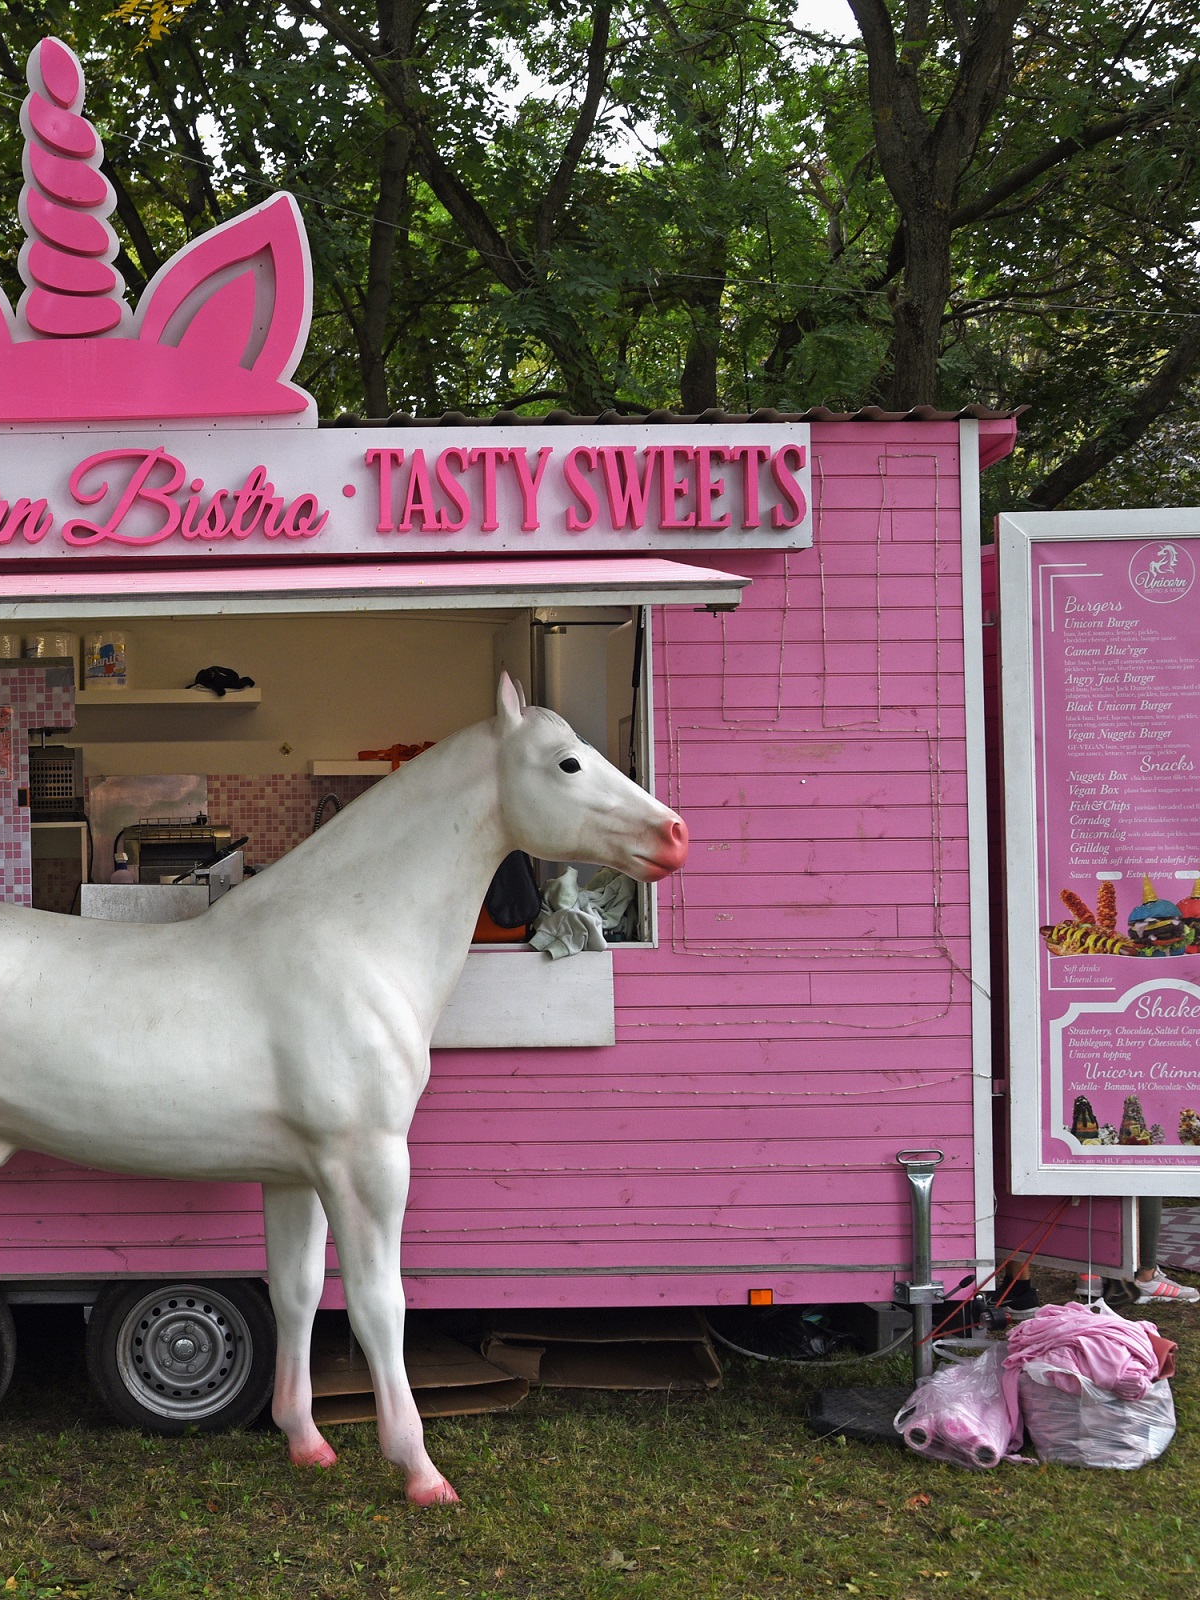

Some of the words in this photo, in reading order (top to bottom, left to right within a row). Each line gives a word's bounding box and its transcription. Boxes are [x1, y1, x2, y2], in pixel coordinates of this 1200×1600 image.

[366, 446, 552, 533] TASTY
[564, 444, 807, 531] SWEETS
[61, 446, 328, 548] Bistro
[1135, 571, 1187, 589] Unicorn
[1065, 596, 1124, 616] Burgers
[1064, 618, 1103, 629] Unicorn
[1107, 617, 1140, 630] Burger
[1065, 646, 1100, 656] Camem
[1064, 674, 1094, 687] Angry
[1095, 673, 1120, 687] Jack
[1123, 673, 1155, 685] Burger
[1066, 702, 1094, 712] Black
[1097, 701, 1136, 711] Unicorn
[1140, 700, 1173, 712] Burger
[1067, 730, 1095, 742] Vegan
[1097, 729, 1136, 741] Nuggets
[1139, 728, 1172, 741] Burger
[1140, 755, 1195, 772] Snacks
[1066, 771, 1105, 783] Nuggets
[1108, 770, 1128, 781] Box
[1069, 785, 1096, 797] Vegan
[1100, 785, 1119, 794] Box
[1069, 800, 1131, 813] Fish&Chips
[1069, 815, 1111, 827] Corndog
[1070, 828, 1127, 841] Unicorndog
[1070, 843, 1110, 855] Grilldog
[1069, 857, 1090, 865] Menu
[1110, 857, 1122, 866] soft
[1124, 856, 1143, 864] drink
[1144, 856, 1158, 864] and
[1160, 856, 1185, 865] colorful
[1186, 855, 1200, 865] frie
[1069, 871, 1092, 879] Sauces
[1126, 870, 1147, 878] Extra
[1148, 871, 1173, 879] topping
[1063, 965, 1078, 974] Soft
[1136, 995, 1200, 1019] Shake
[1068, 1026, 1112, 1037] Strawberry,
[1181, 1026, 1200, 1035] Cara
[1068, 1038, 1113, 1049] Bubblegum,
[1116, 1038, 1145, 1049] B.berry
[1148, 1038, 1192, 1048] Cheesecake,
[1069, 1050, 1100, 1059] Unicorn
[1103, 1050, 1132, 1061] topping
[1084, 1062, 1145, 1080] Unicorn
